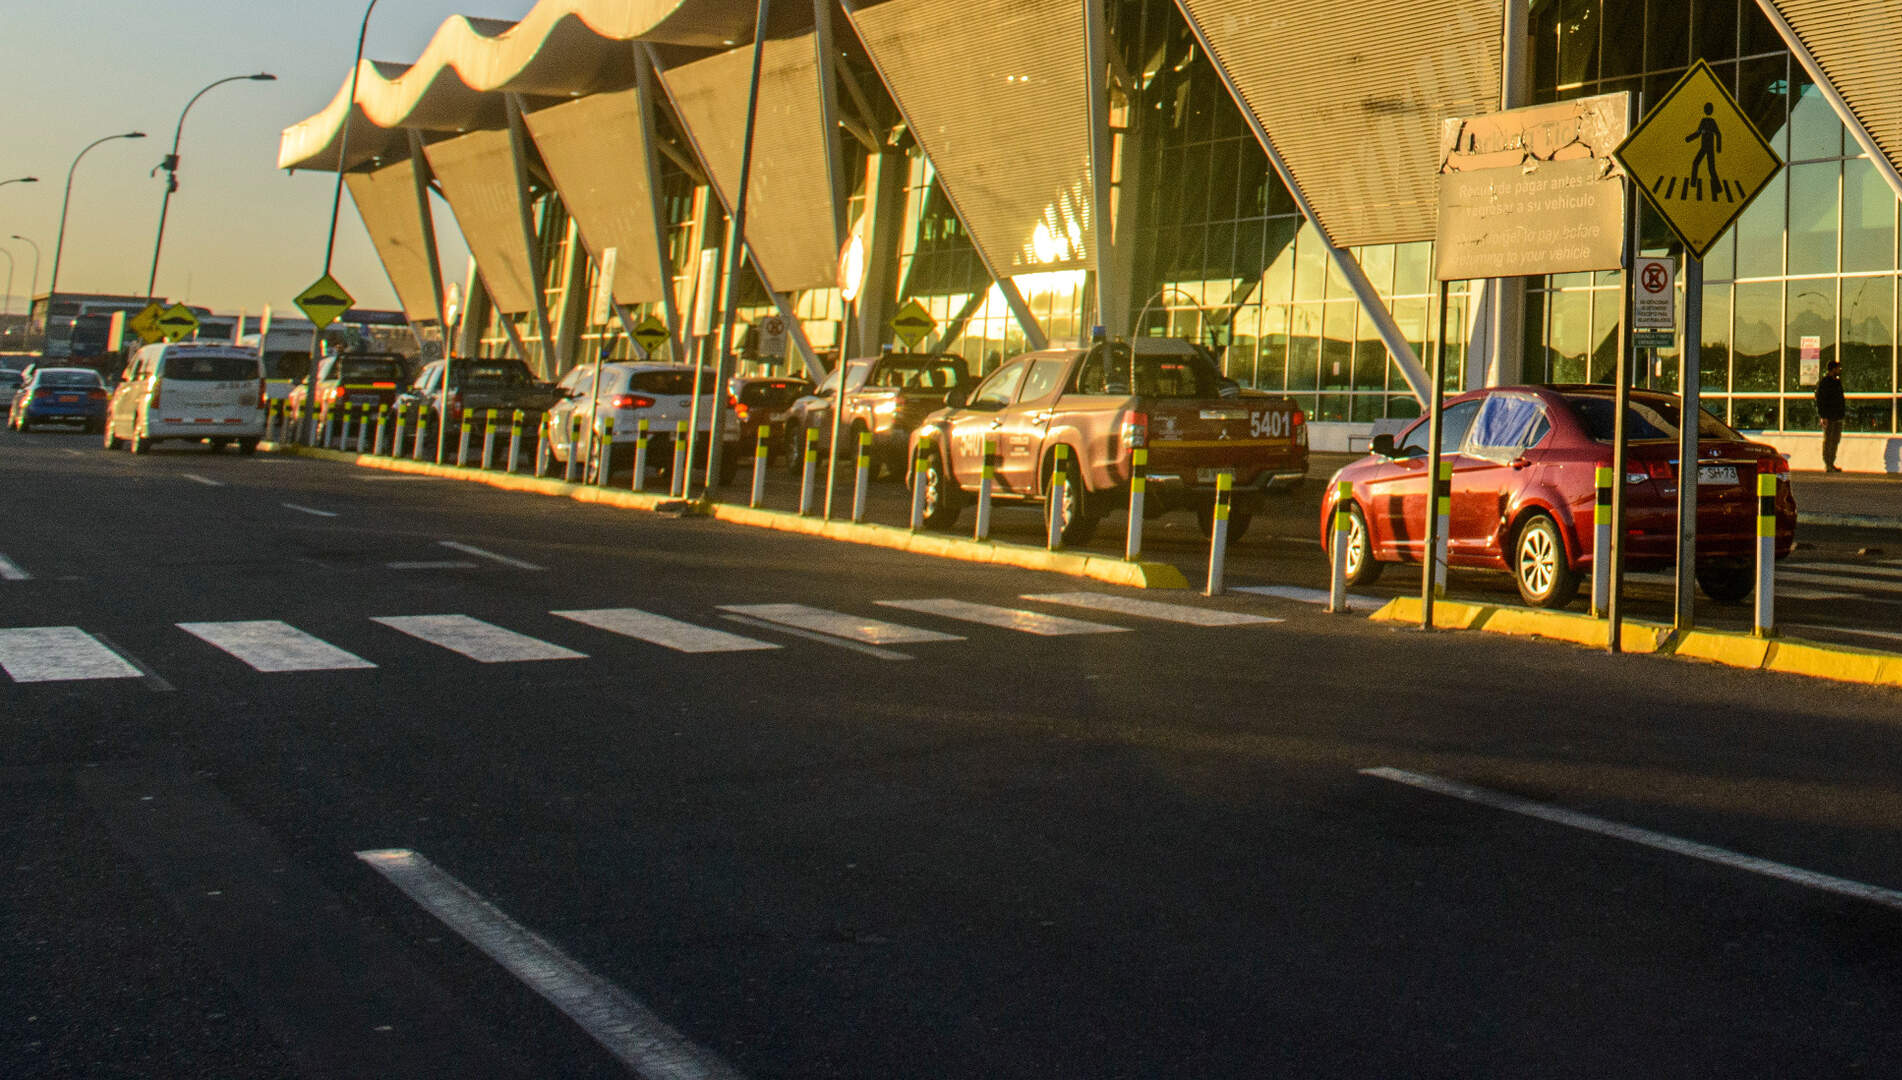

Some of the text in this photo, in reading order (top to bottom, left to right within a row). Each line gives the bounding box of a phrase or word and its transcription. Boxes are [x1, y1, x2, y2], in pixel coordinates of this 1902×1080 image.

[1515, 179, 1548, 196] pagar
[1551, 176, 1582, 190] antes
[1516, 201, 1524, 213] a
[1527, 199, 1541, 212] su
[1250, 411, 1291, 438] 5401
